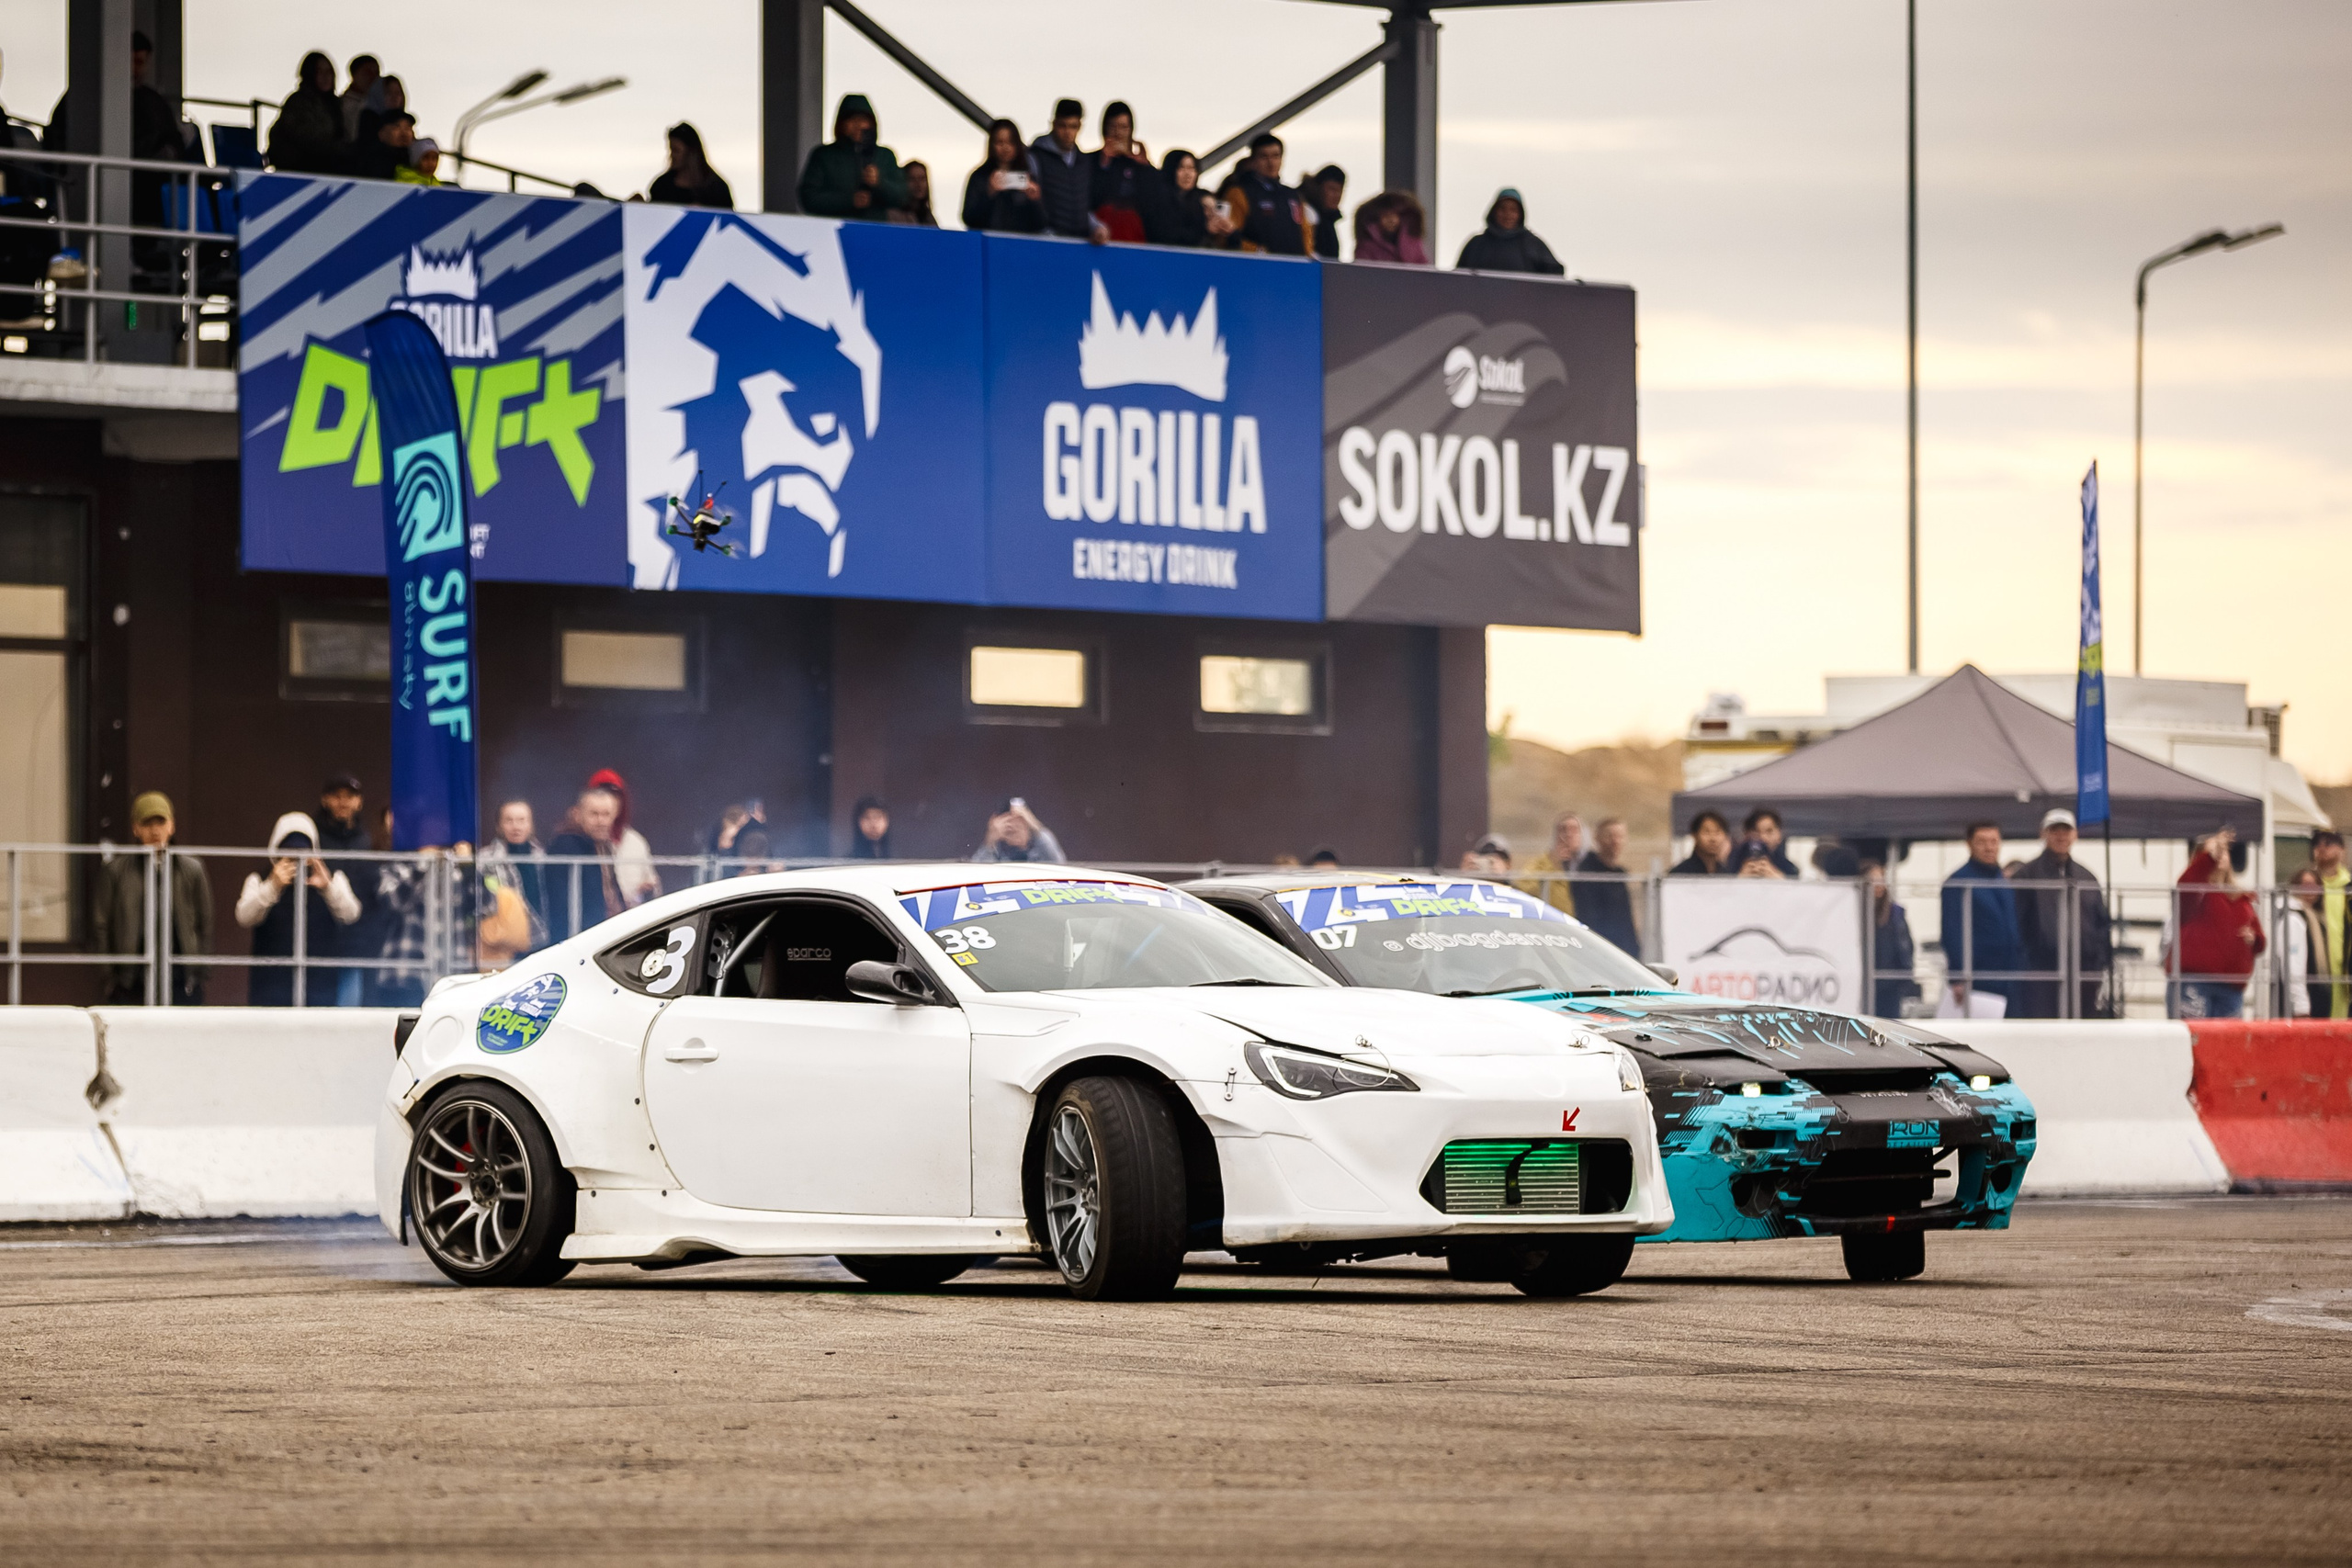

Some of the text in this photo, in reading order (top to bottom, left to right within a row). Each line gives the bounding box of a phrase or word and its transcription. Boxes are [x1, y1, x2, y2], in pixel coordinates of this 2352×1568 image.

[390, 301, 499, 358] RILLA
[1043, 401, 1266, 534] GORILLA
[1338, 426, 1630, 547] SOKOL.KZ
[1073, 538, 1238, 590] ENERGY DRINK
[419, 569, 472, 743] SURF
[934, 926, 997, 953] 38
[1310, 924, 1358, 950] 07
